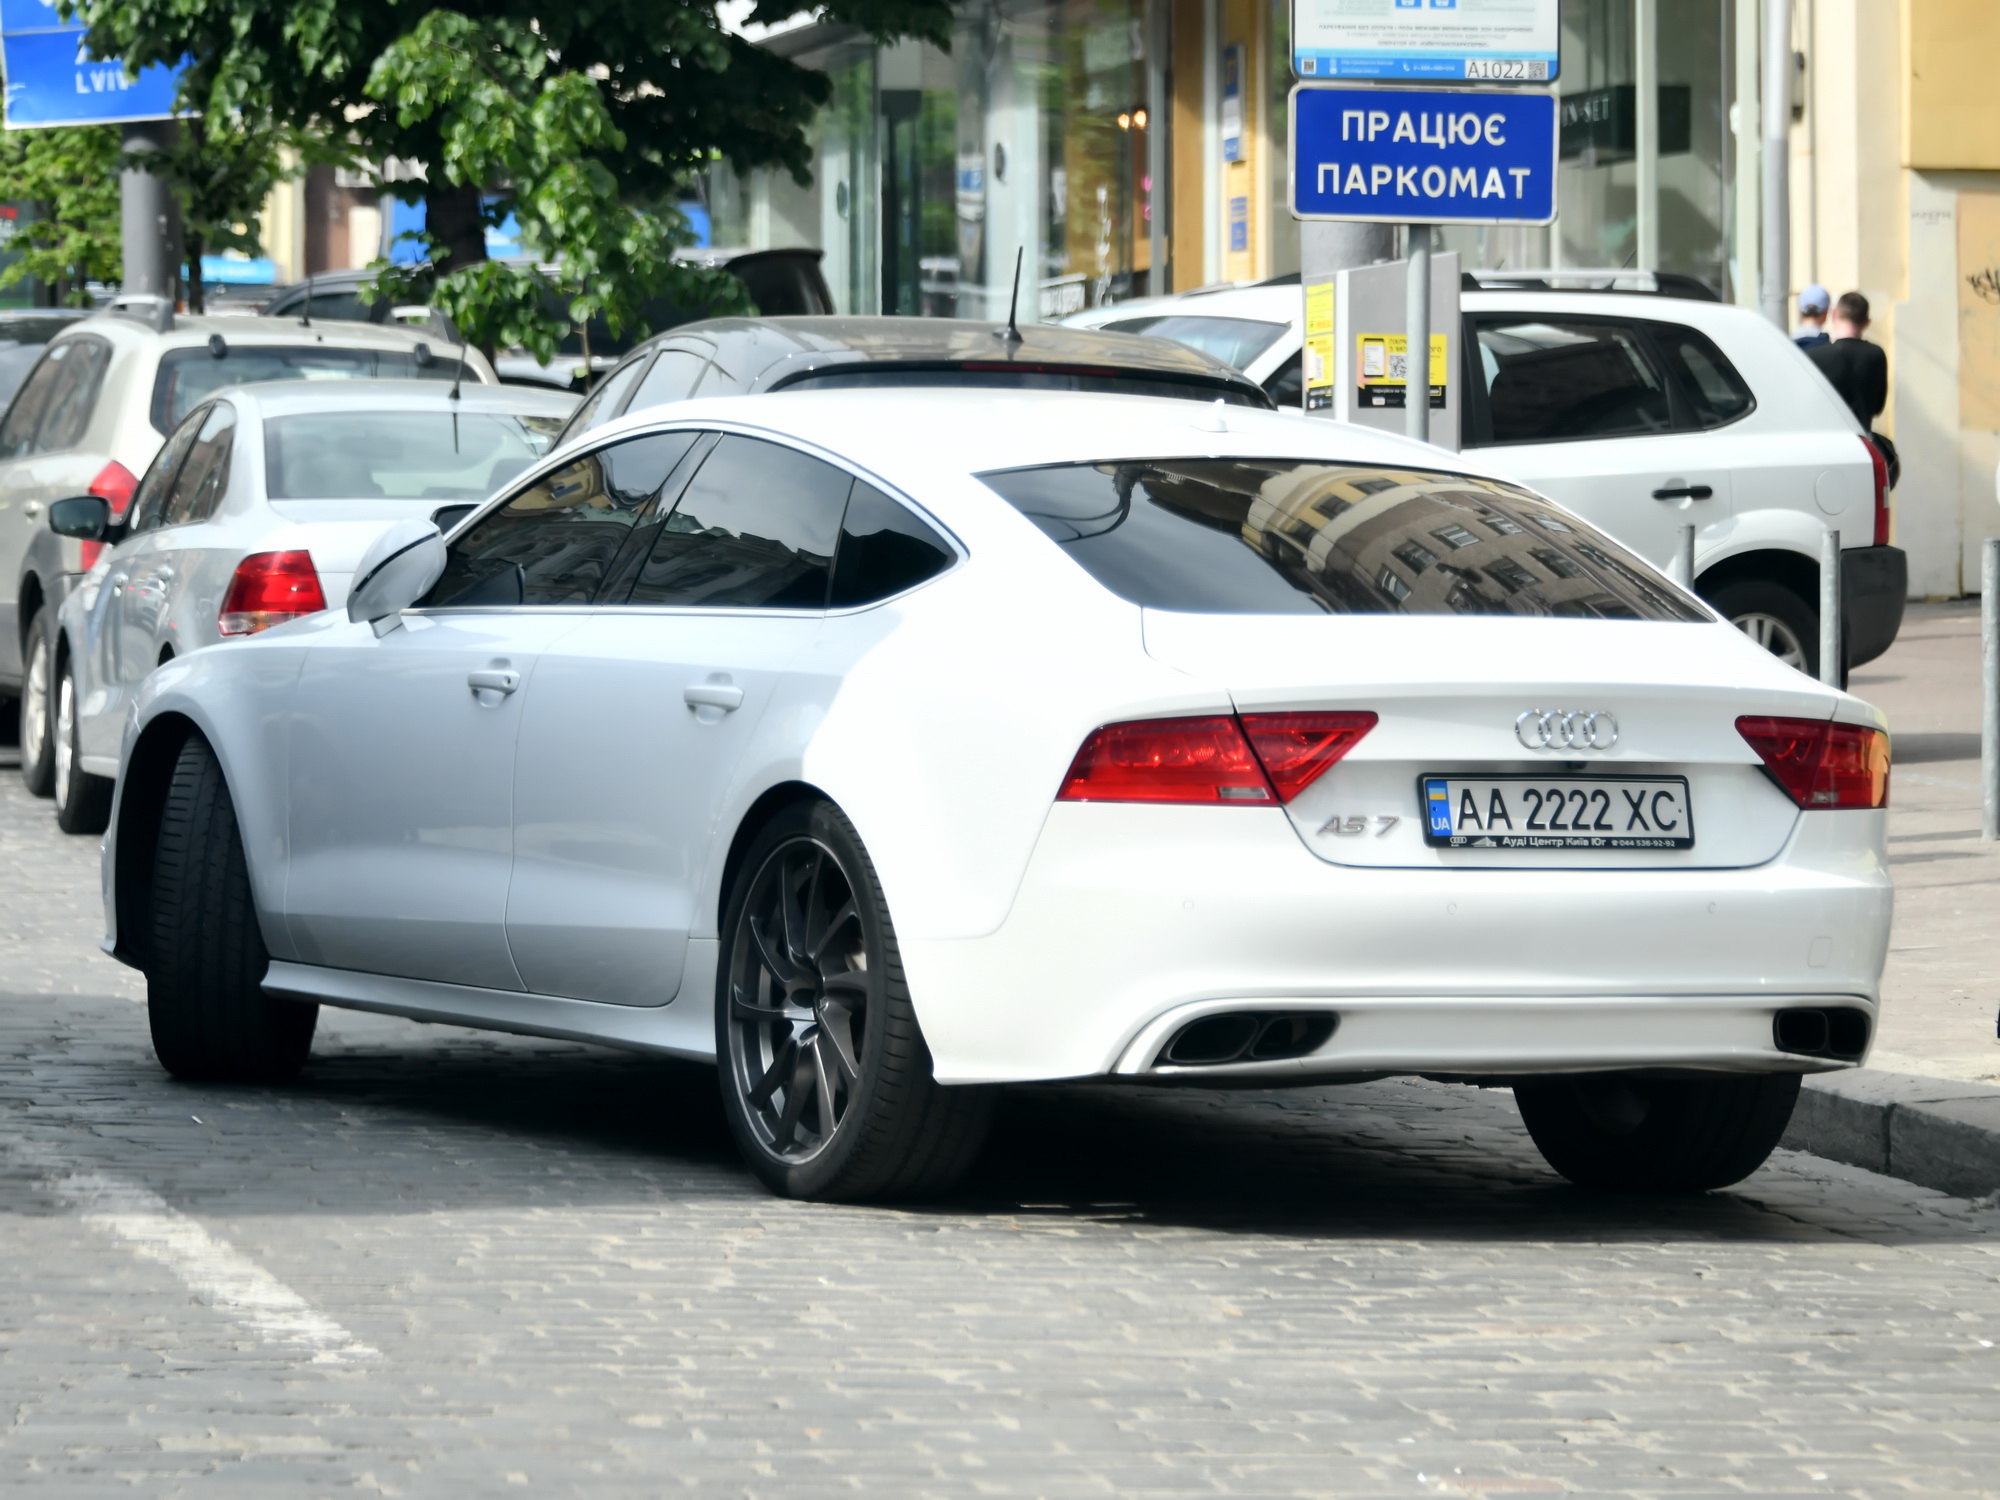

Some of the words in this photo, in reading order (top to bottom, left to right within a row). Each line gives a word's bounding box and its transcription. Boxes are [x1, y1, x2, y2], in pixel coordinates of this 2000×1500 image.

[1467, 62, 1524, 79] A1022
[1342, 110, 1506, 149] ПРАЦЮЄ
[1317, 163, 1531, 200] ПАРКОМАТ
[1431, 817, 1450, 830] UA
[1457, 788, 1513, 830] AA
[1523, 788, 1613, 831] 2222
[1622, 789, 1677, 832] XC
[1529, 837, 1564, 847] Центр
